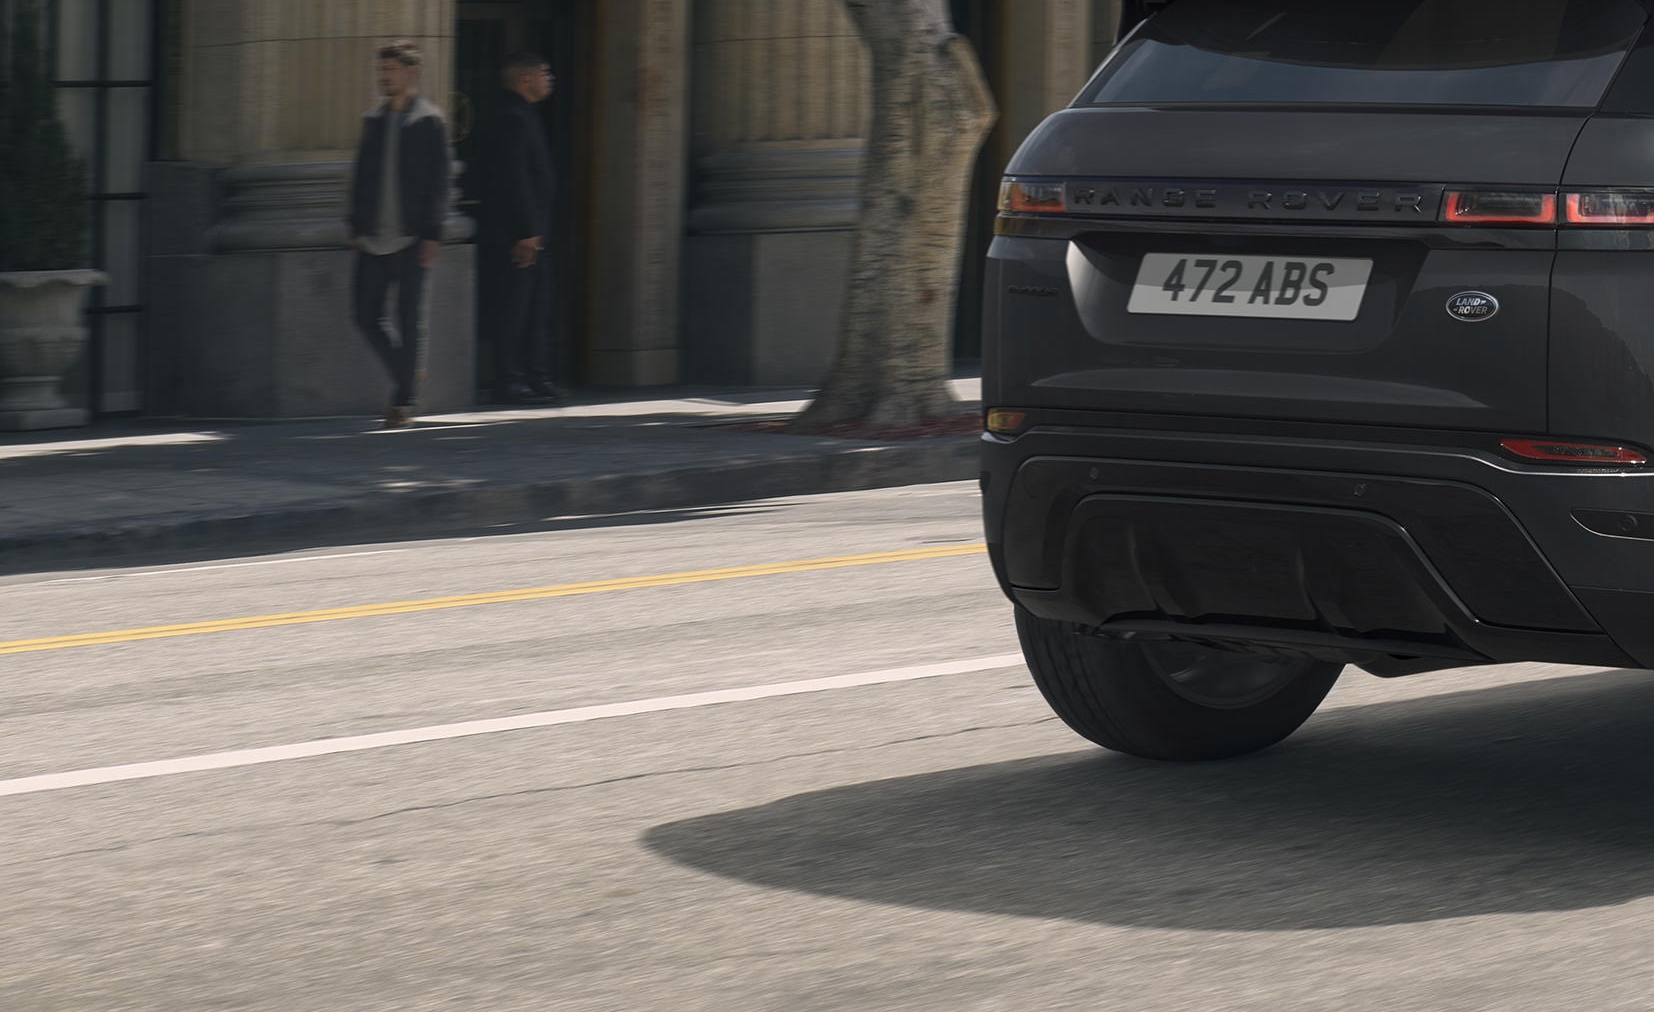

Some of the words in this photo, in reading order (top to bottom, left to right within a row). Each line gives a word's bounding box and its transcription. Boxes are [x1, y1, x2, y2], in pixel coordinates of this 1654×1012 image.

[1073, 188, 1217, 208] RANGE
[1247, 190, 1422, 213] ROVER
[1162, 258, 1243, 304] 472
[1247, 261, 1335, 307] ABS
[1456, 297, 1481, 306] LAND
[1457, 306, 1488, 315] ROVER
